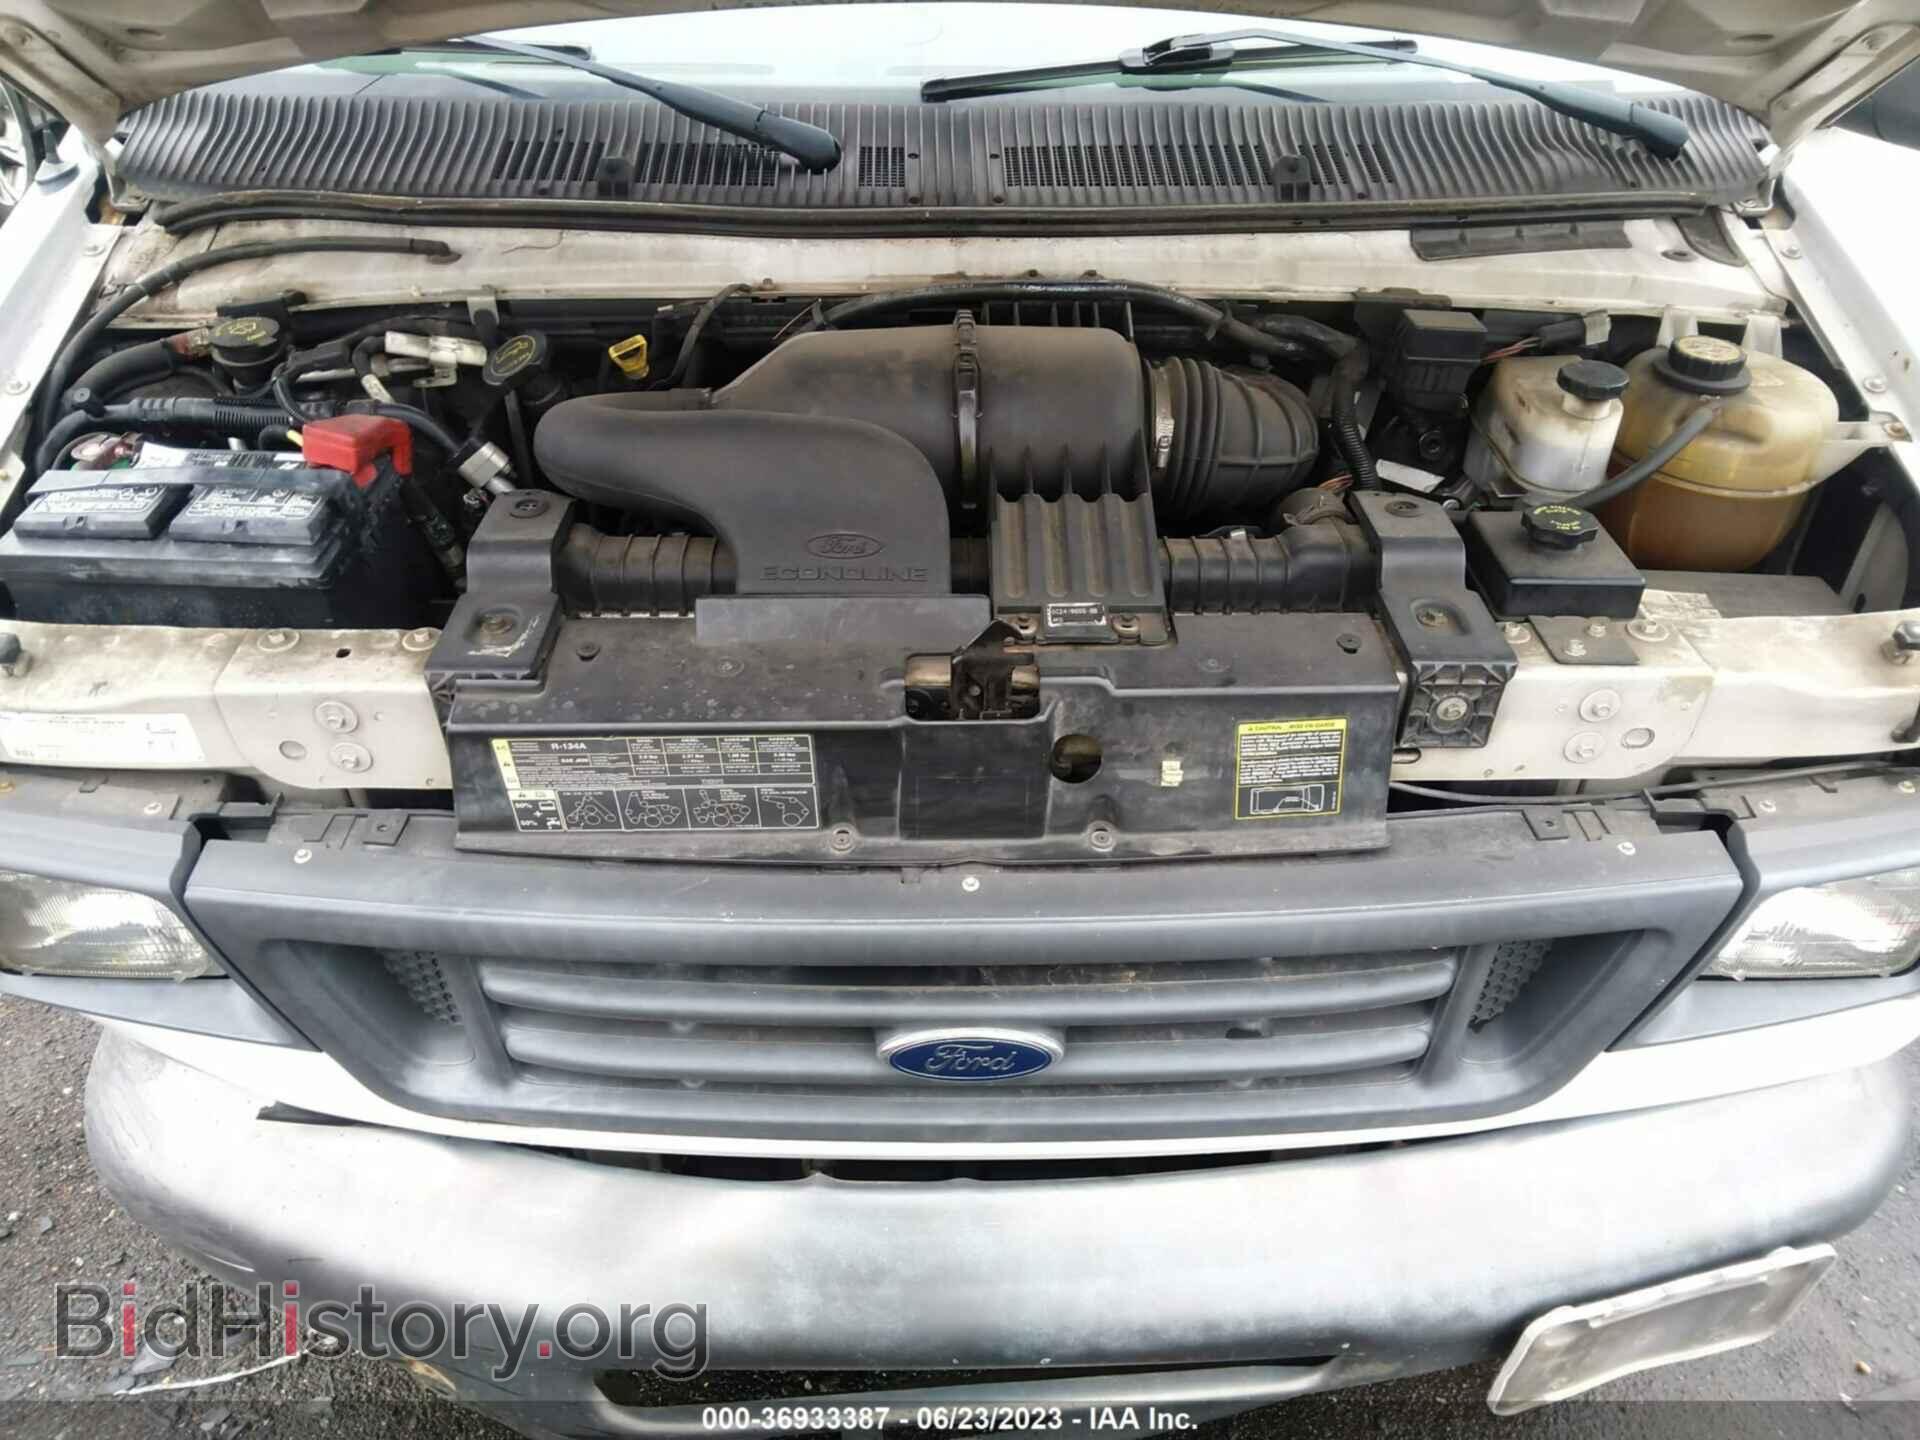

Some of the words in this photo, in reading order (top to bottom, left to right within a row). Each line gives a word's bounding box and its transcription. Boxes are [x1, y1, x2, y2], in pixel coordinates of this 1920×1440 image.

[818, 535, 868, 554] Ford
[760, 566, 928, 582] ECONOLINE
[925, 1043, 1017, 1071] Ford
